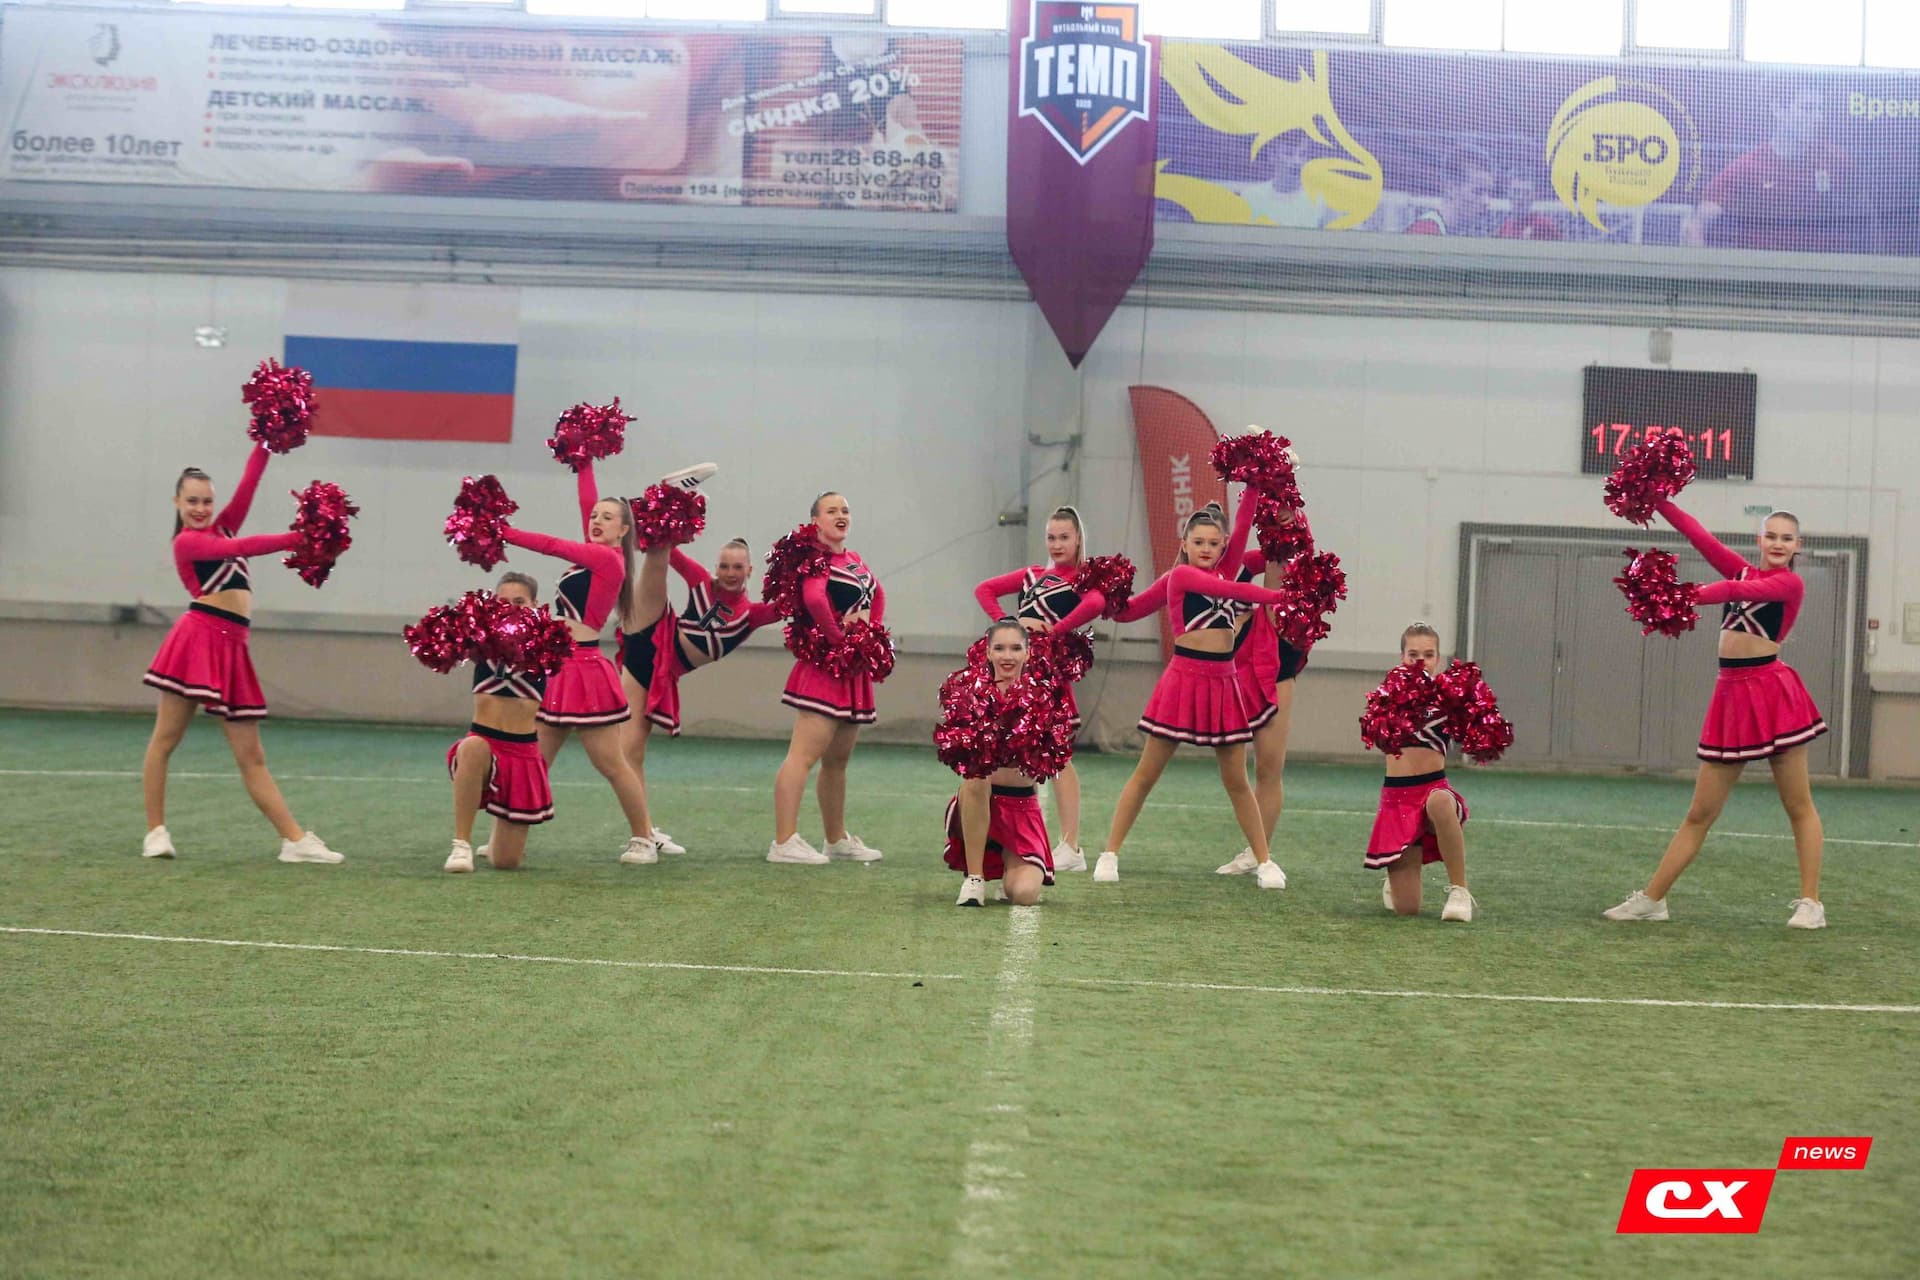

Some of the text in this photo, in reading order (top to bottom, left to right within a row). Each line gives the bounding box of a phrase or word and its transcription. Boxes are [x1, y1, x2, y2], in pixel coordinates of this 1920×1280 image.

[570, 46, 682, 65] МАССАЖ:
[1034, 43, 1138, 103] ТЕМП
[208, 88, 315, 109] ДЕТСКИЙ
[728, 64, 920, 136] скидка 20%
[12, 130, 95, 152] более
